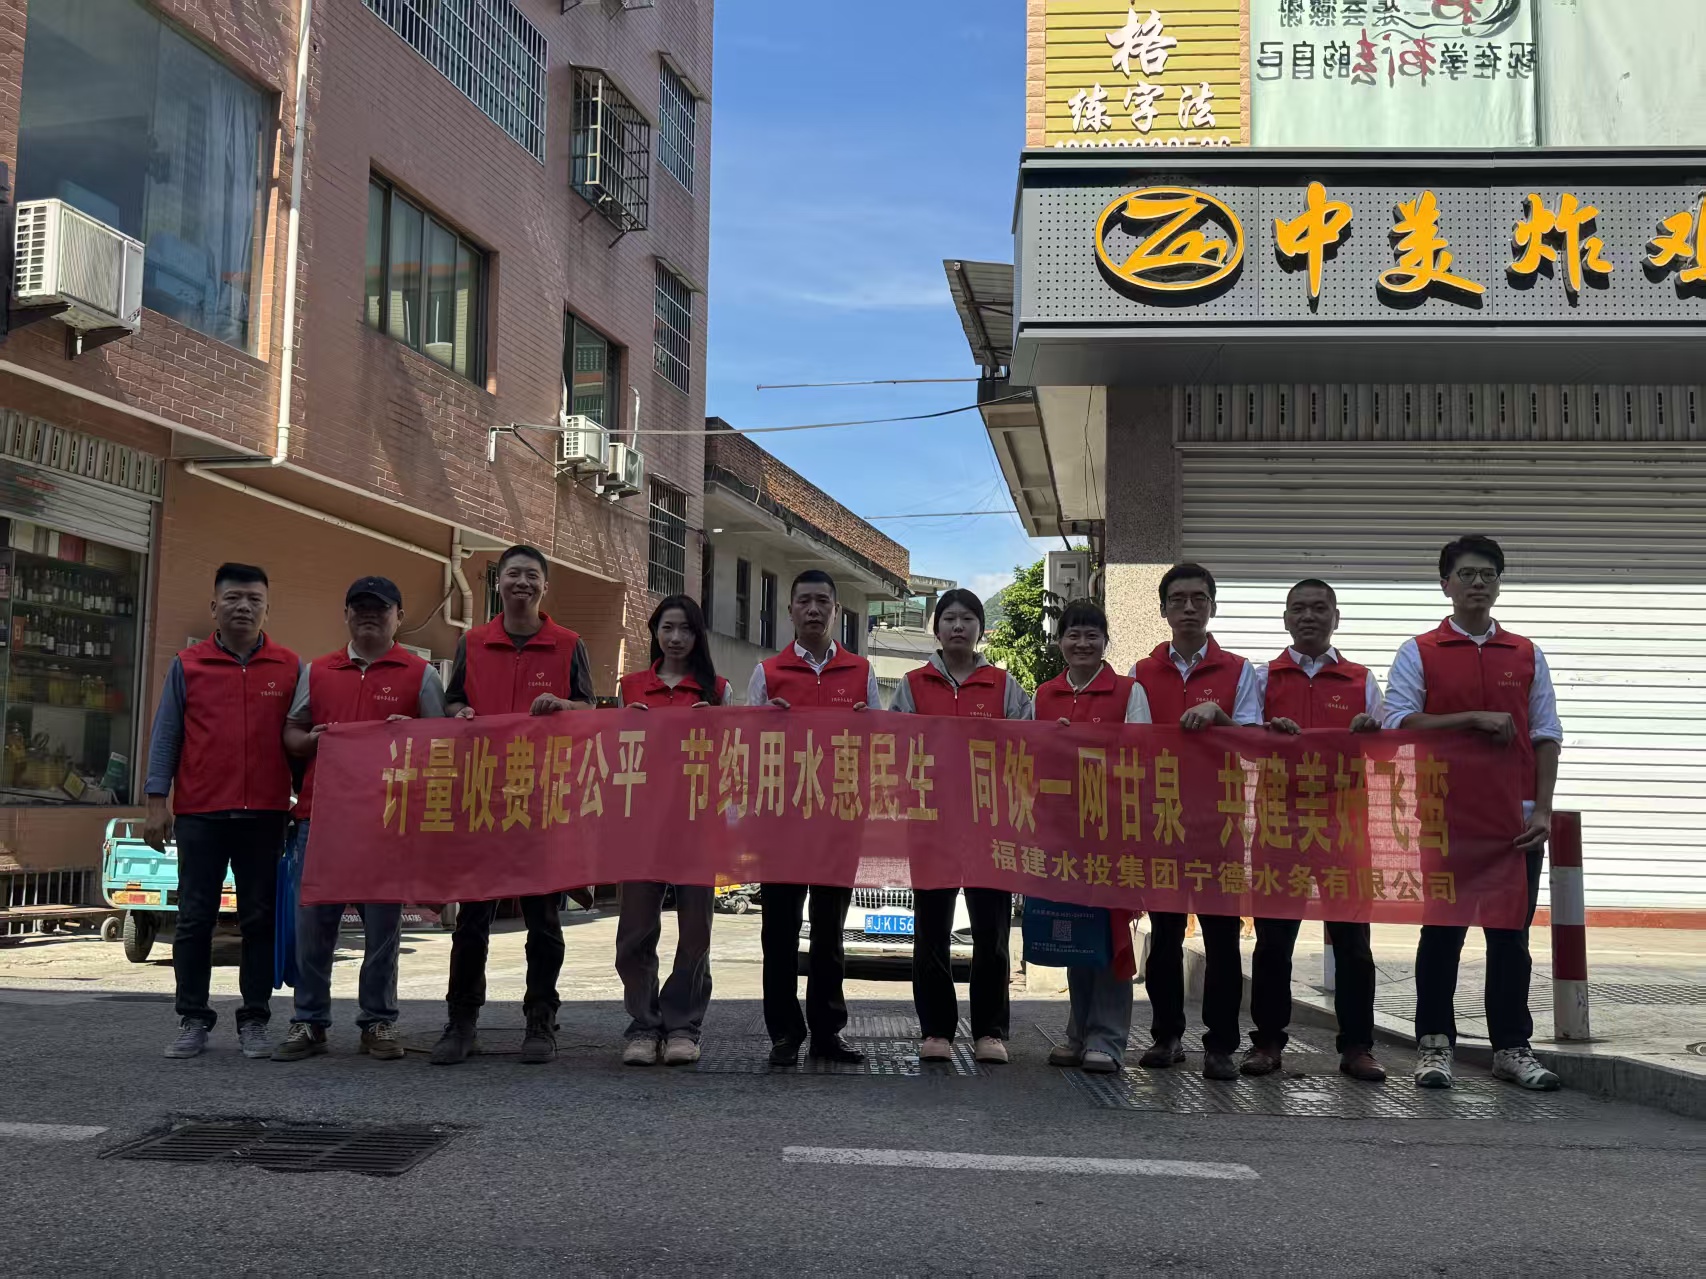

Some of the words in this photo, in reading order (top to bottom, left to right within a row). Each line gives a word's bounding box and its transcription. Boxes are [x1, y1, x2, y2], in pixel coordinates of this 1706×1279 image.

[1067, 80, 1216, 134] 练字法
[381, 730, 647, 835] 计量收费促公平
[680, 727, 938, 822] 节约用水惠民生
[969, 738, 1186, 845] 同饮一网甘泉
[991, 838, 1457, 905] 福建水投集团宁德水务有限公司
